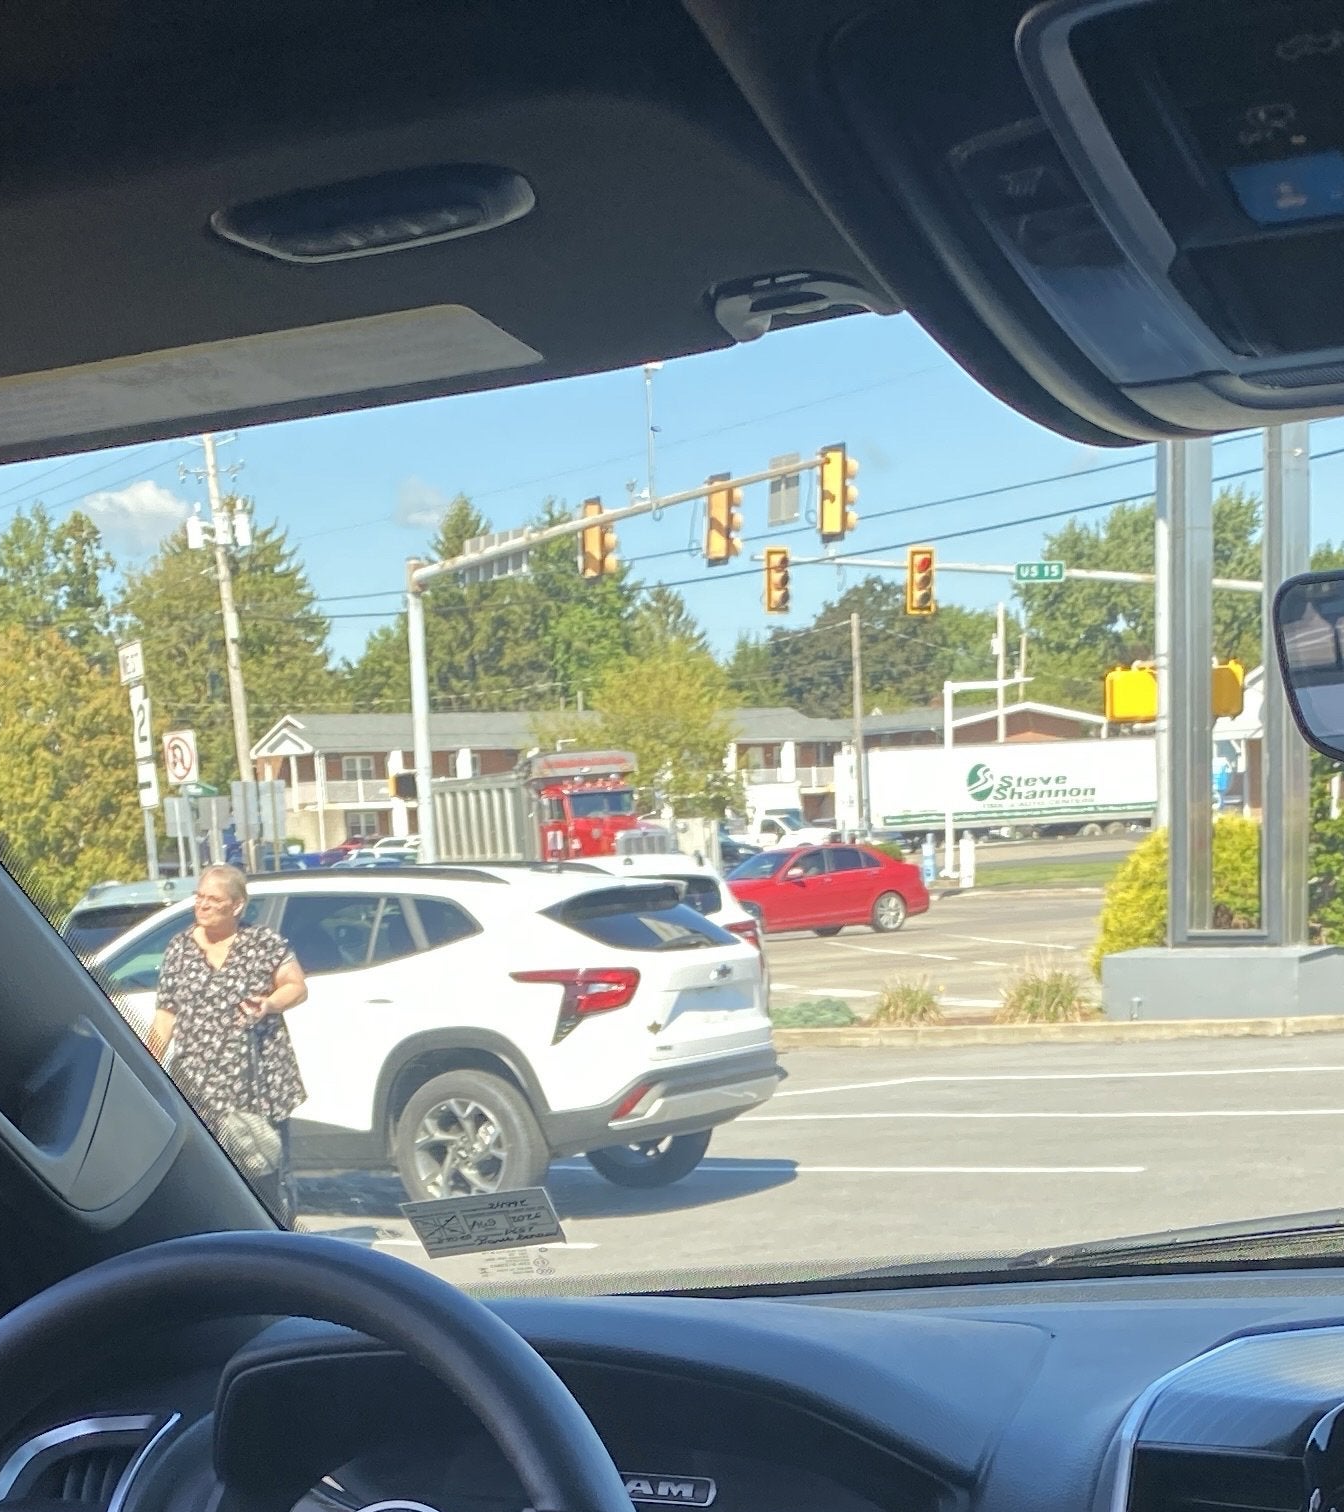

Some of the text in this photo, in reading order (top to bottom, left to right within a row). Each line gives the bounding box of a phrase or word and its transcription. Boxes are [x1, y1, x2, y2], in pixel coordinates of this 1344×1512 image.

[1020, 564, 1060, 577] US 15
[998, 774, 1068, 788] Steve
[993, 786, 1096, 802] Shannon
[625, 1479, 695, 1500] AM
